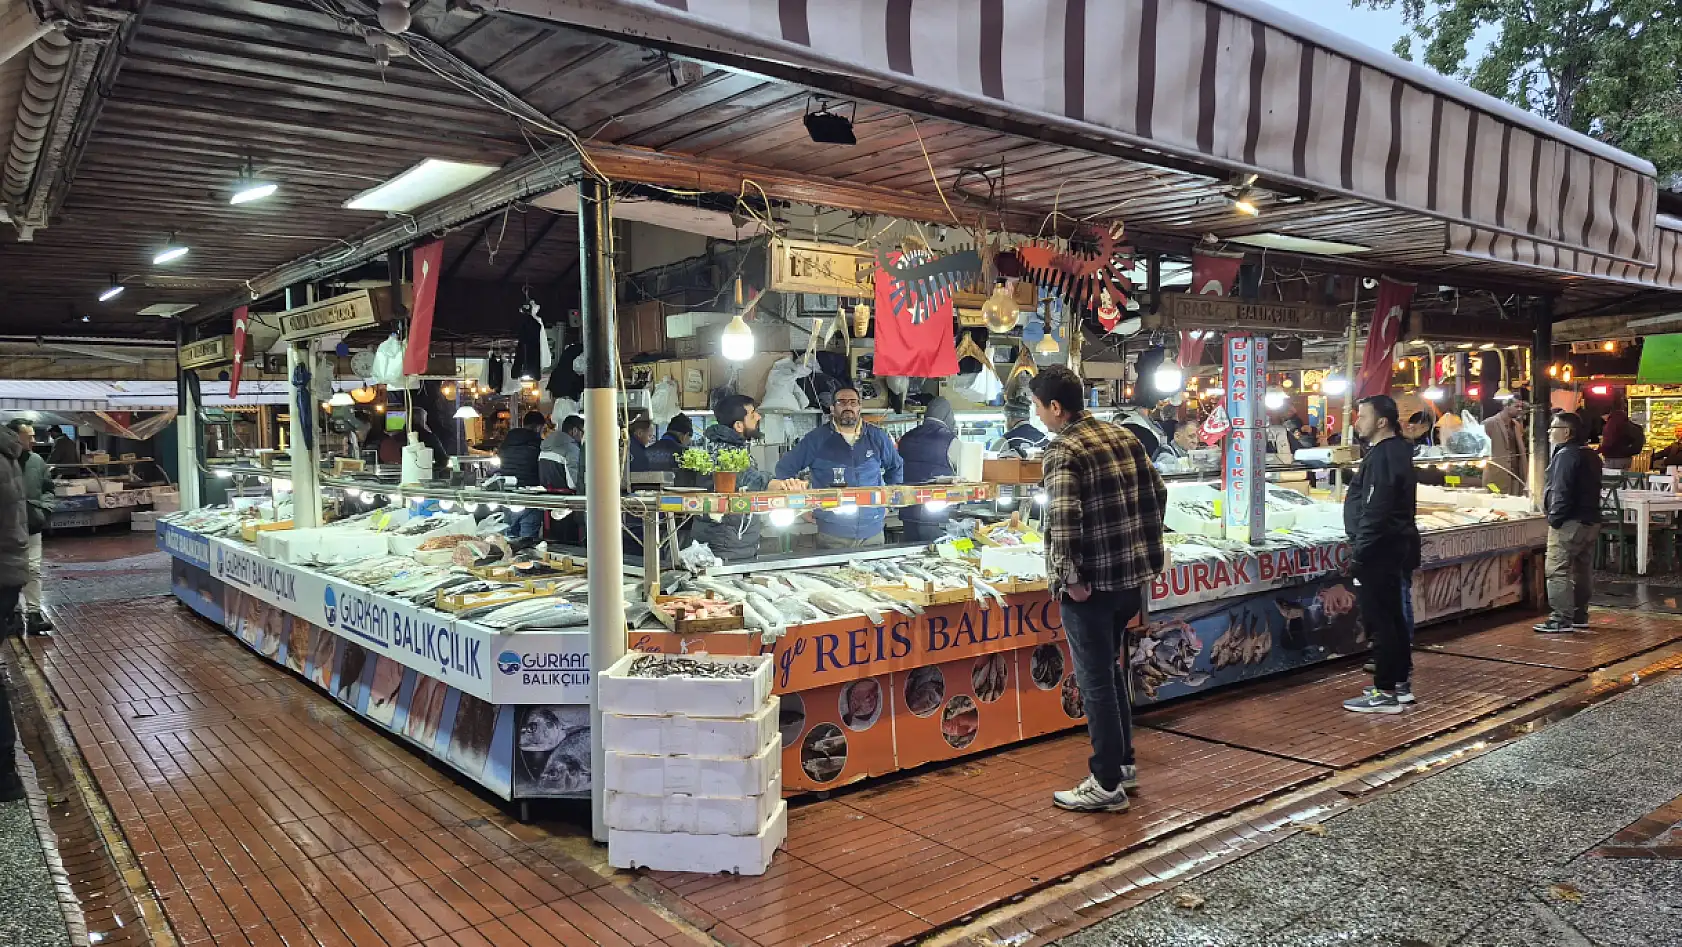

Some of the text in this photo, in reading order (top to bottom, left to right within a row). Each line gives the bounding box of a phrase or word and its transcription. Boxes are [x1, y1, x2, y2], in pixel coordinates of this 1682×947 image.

[1231, 341, 1247, 402] BURAK
[1255, 341, 1265, 402] BURAK
[225, 550, 296, 602] GÜRKAN BALIKÇILIK
[1151, 556, 1250, 600] BURAK
[340, 592, 482, 679] GÜRKAN BALIKÇILIK
[813, 620, 912, 673] REIS
